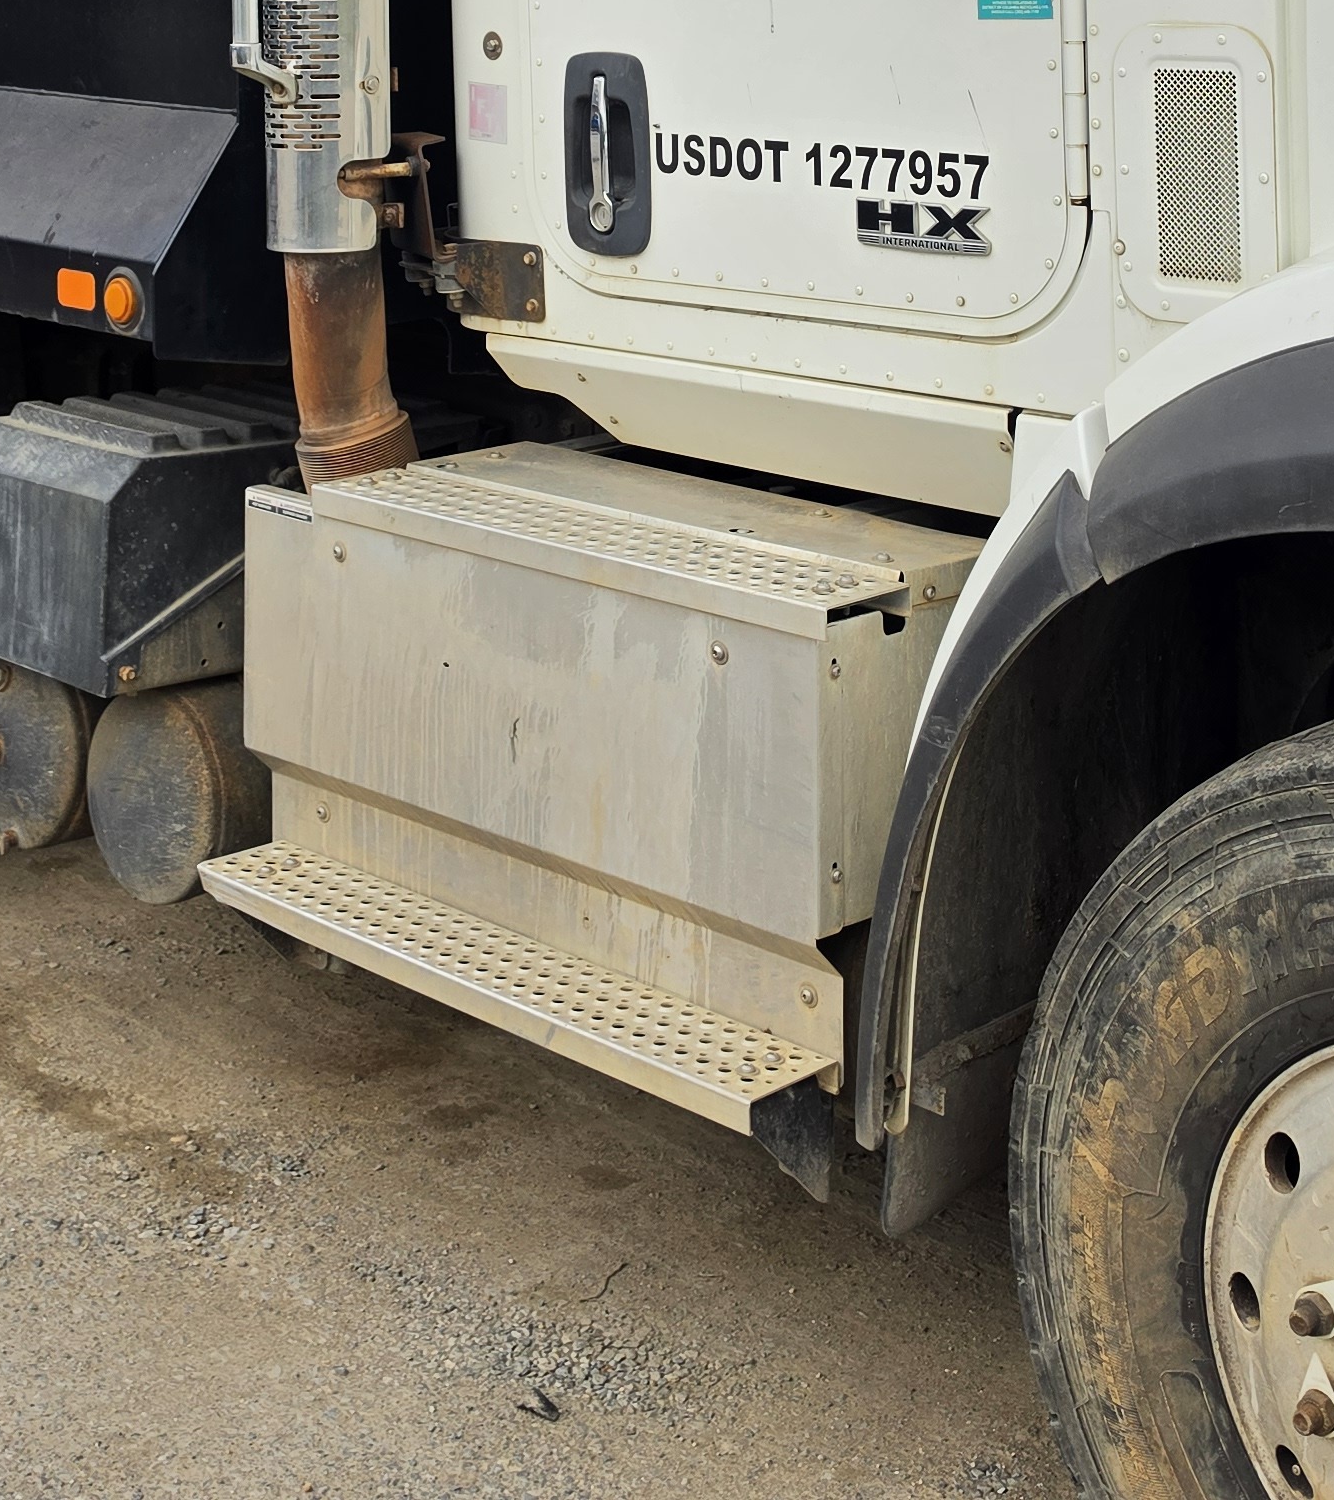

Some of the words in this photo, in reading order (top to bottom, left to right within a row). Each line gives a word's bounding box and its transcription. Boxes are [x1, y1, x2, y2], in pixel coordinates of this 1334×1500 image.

[655, 132, 789, 183] USDOT
[805, 142, 990, 200] 1277957
[856, 197, 991, 243] HX
[882, 235, 960, 252] INTERNATIONAL
